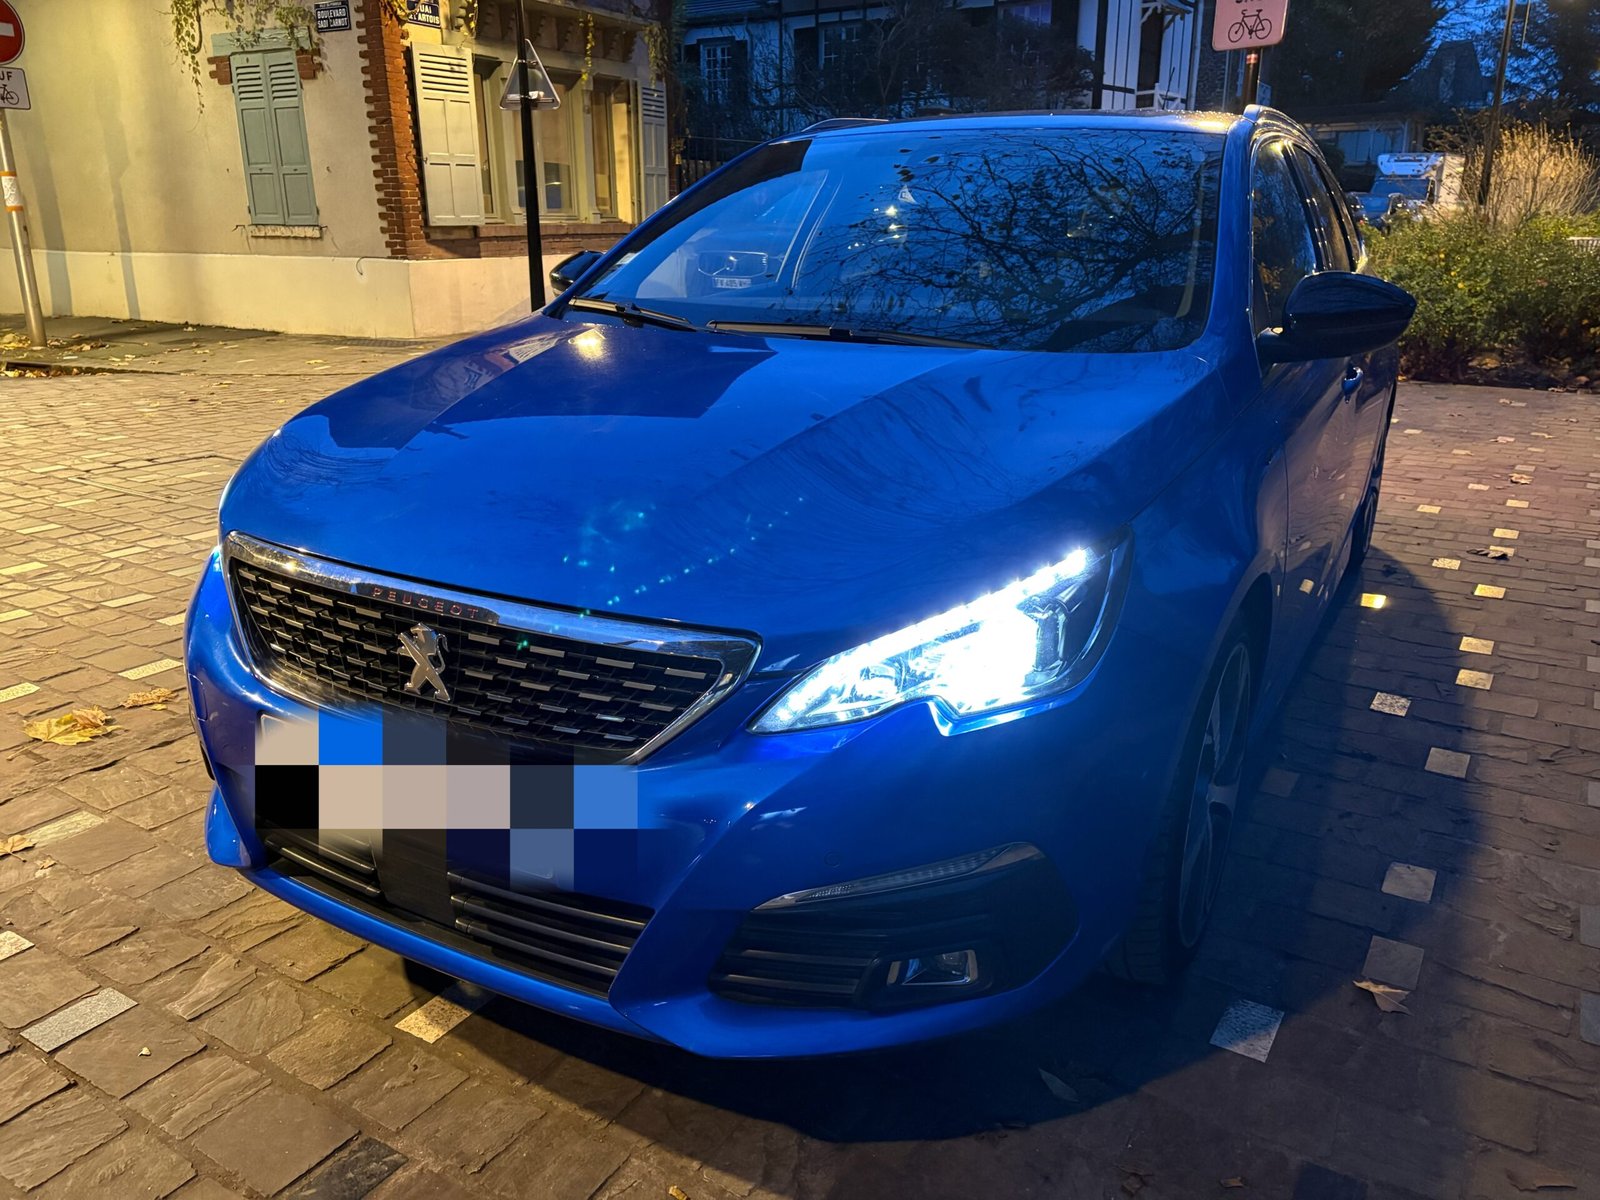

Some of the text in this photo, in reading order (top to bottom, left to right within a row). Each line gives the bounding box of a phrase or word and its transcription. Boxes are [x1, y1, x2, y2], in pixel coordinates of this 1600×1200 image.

[317, 8, 347, 20] BOULEVARD
[317, 18, 348, 29] SADI CARNOT
[372, 586, 479, 619] PEUGEOT
